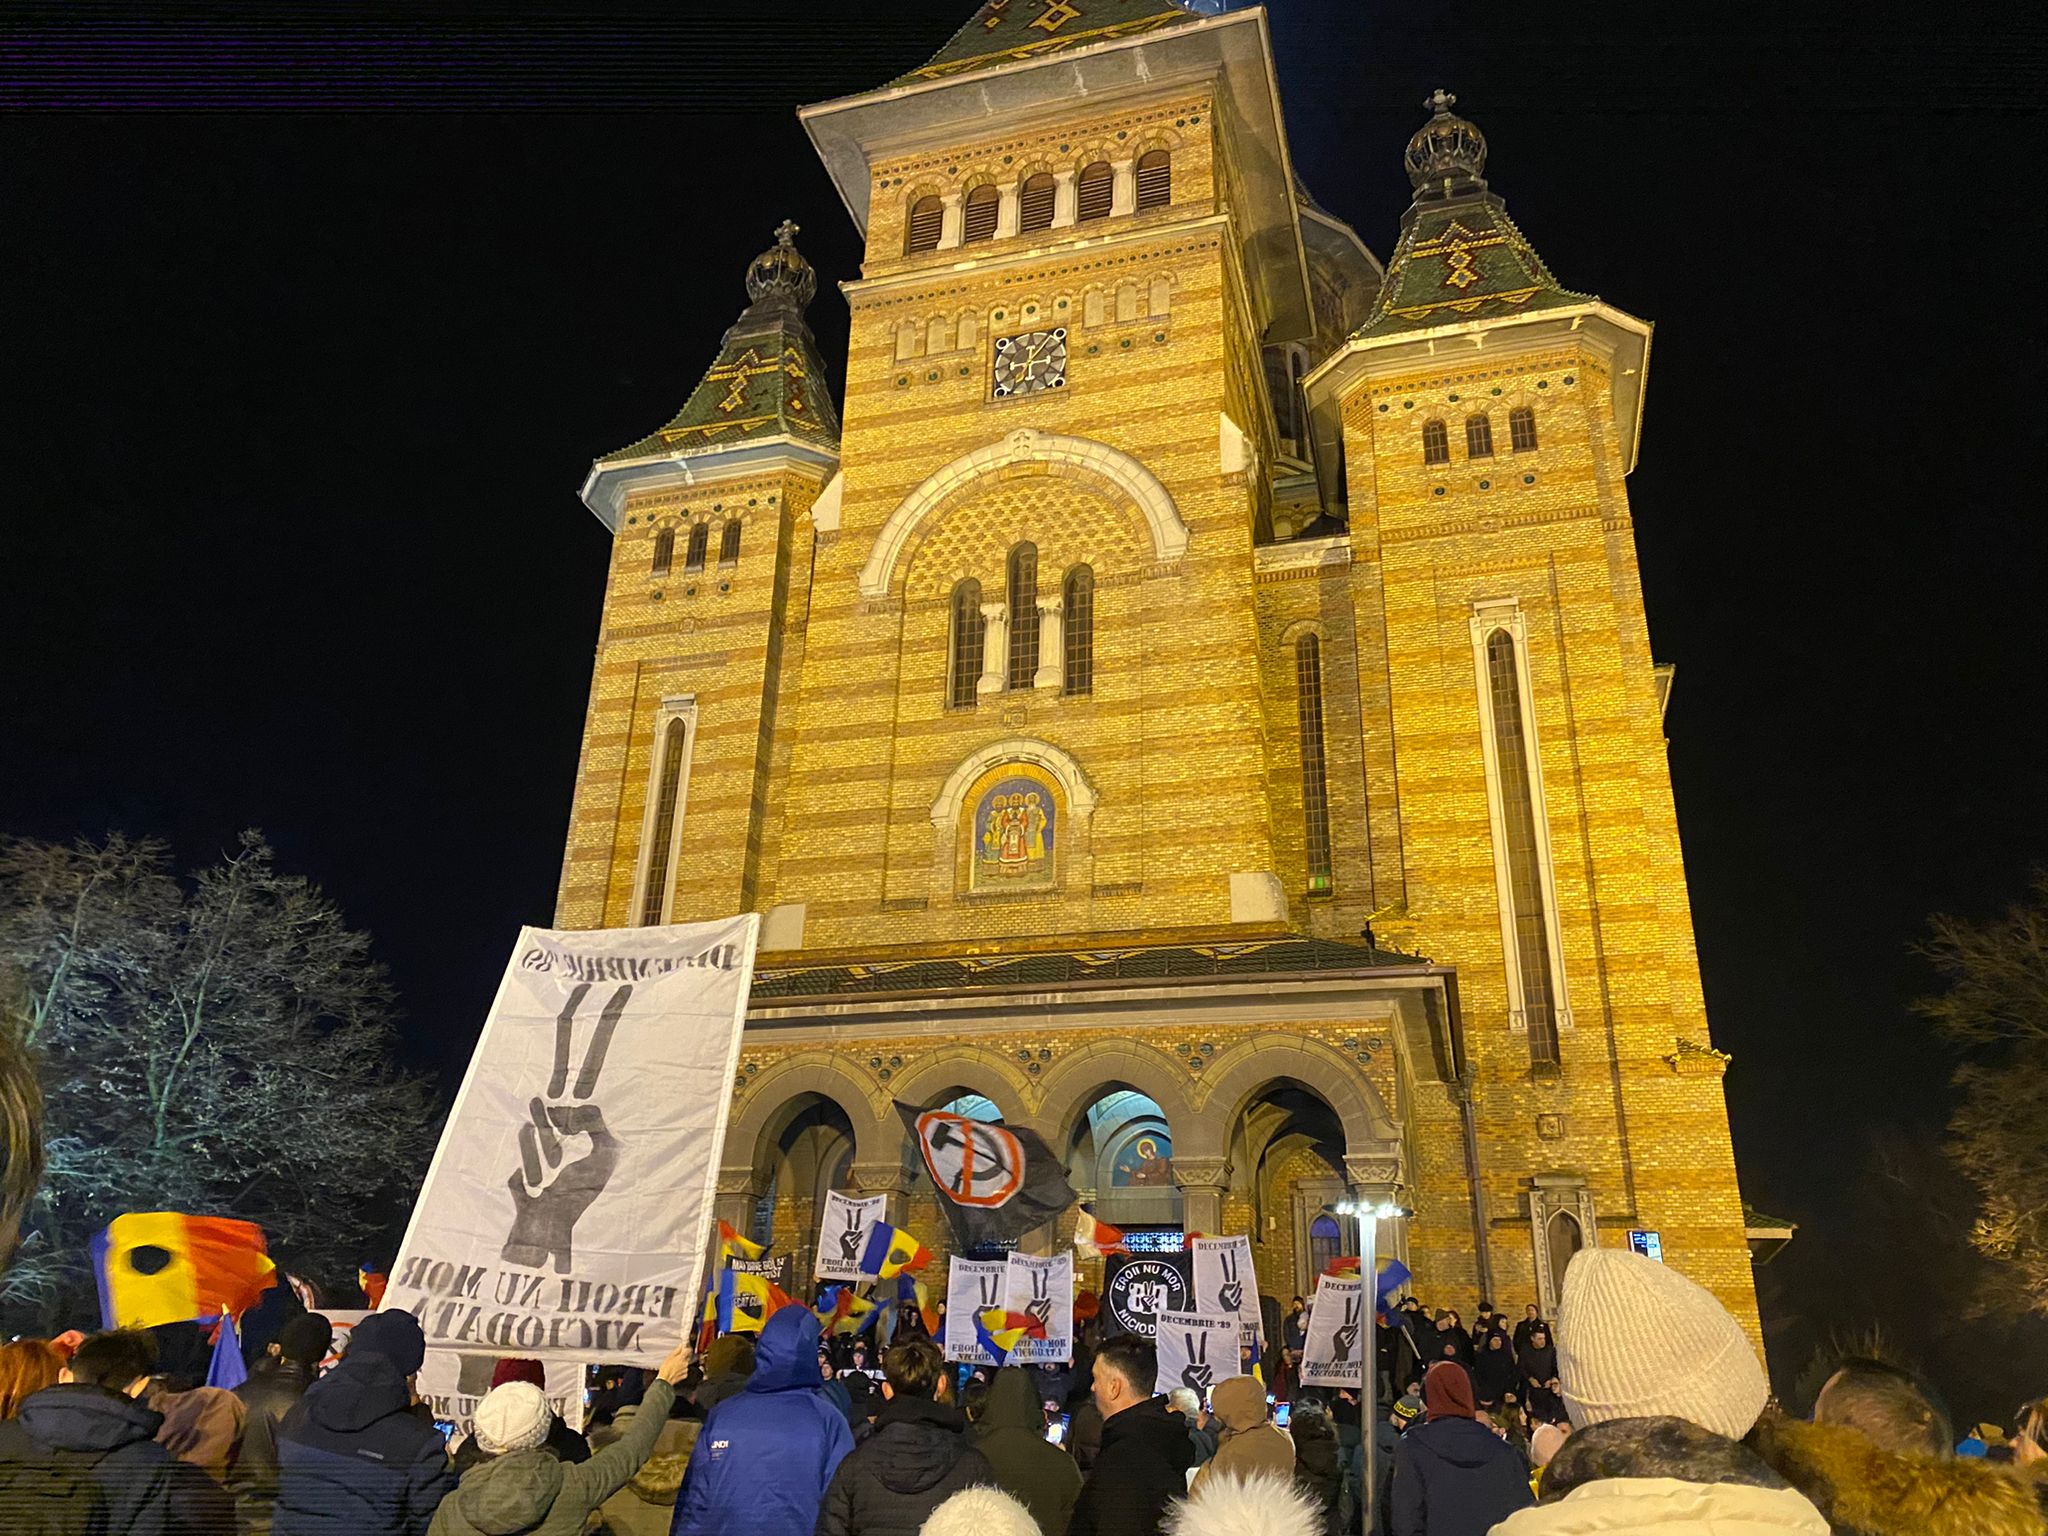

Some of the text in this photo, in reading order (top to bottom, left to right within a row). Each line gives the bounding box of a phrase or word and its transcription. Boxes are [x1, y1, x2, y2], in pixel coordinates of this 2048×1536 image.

[825, 1266, 858, 1274] NICIODA
[1114, 1264, 1181, 1292] EROII NU MOR
[1118, 1309, 1156, 1334] NICIOD
[1161, 1314, 1215, 1328] DECEMBRIE
